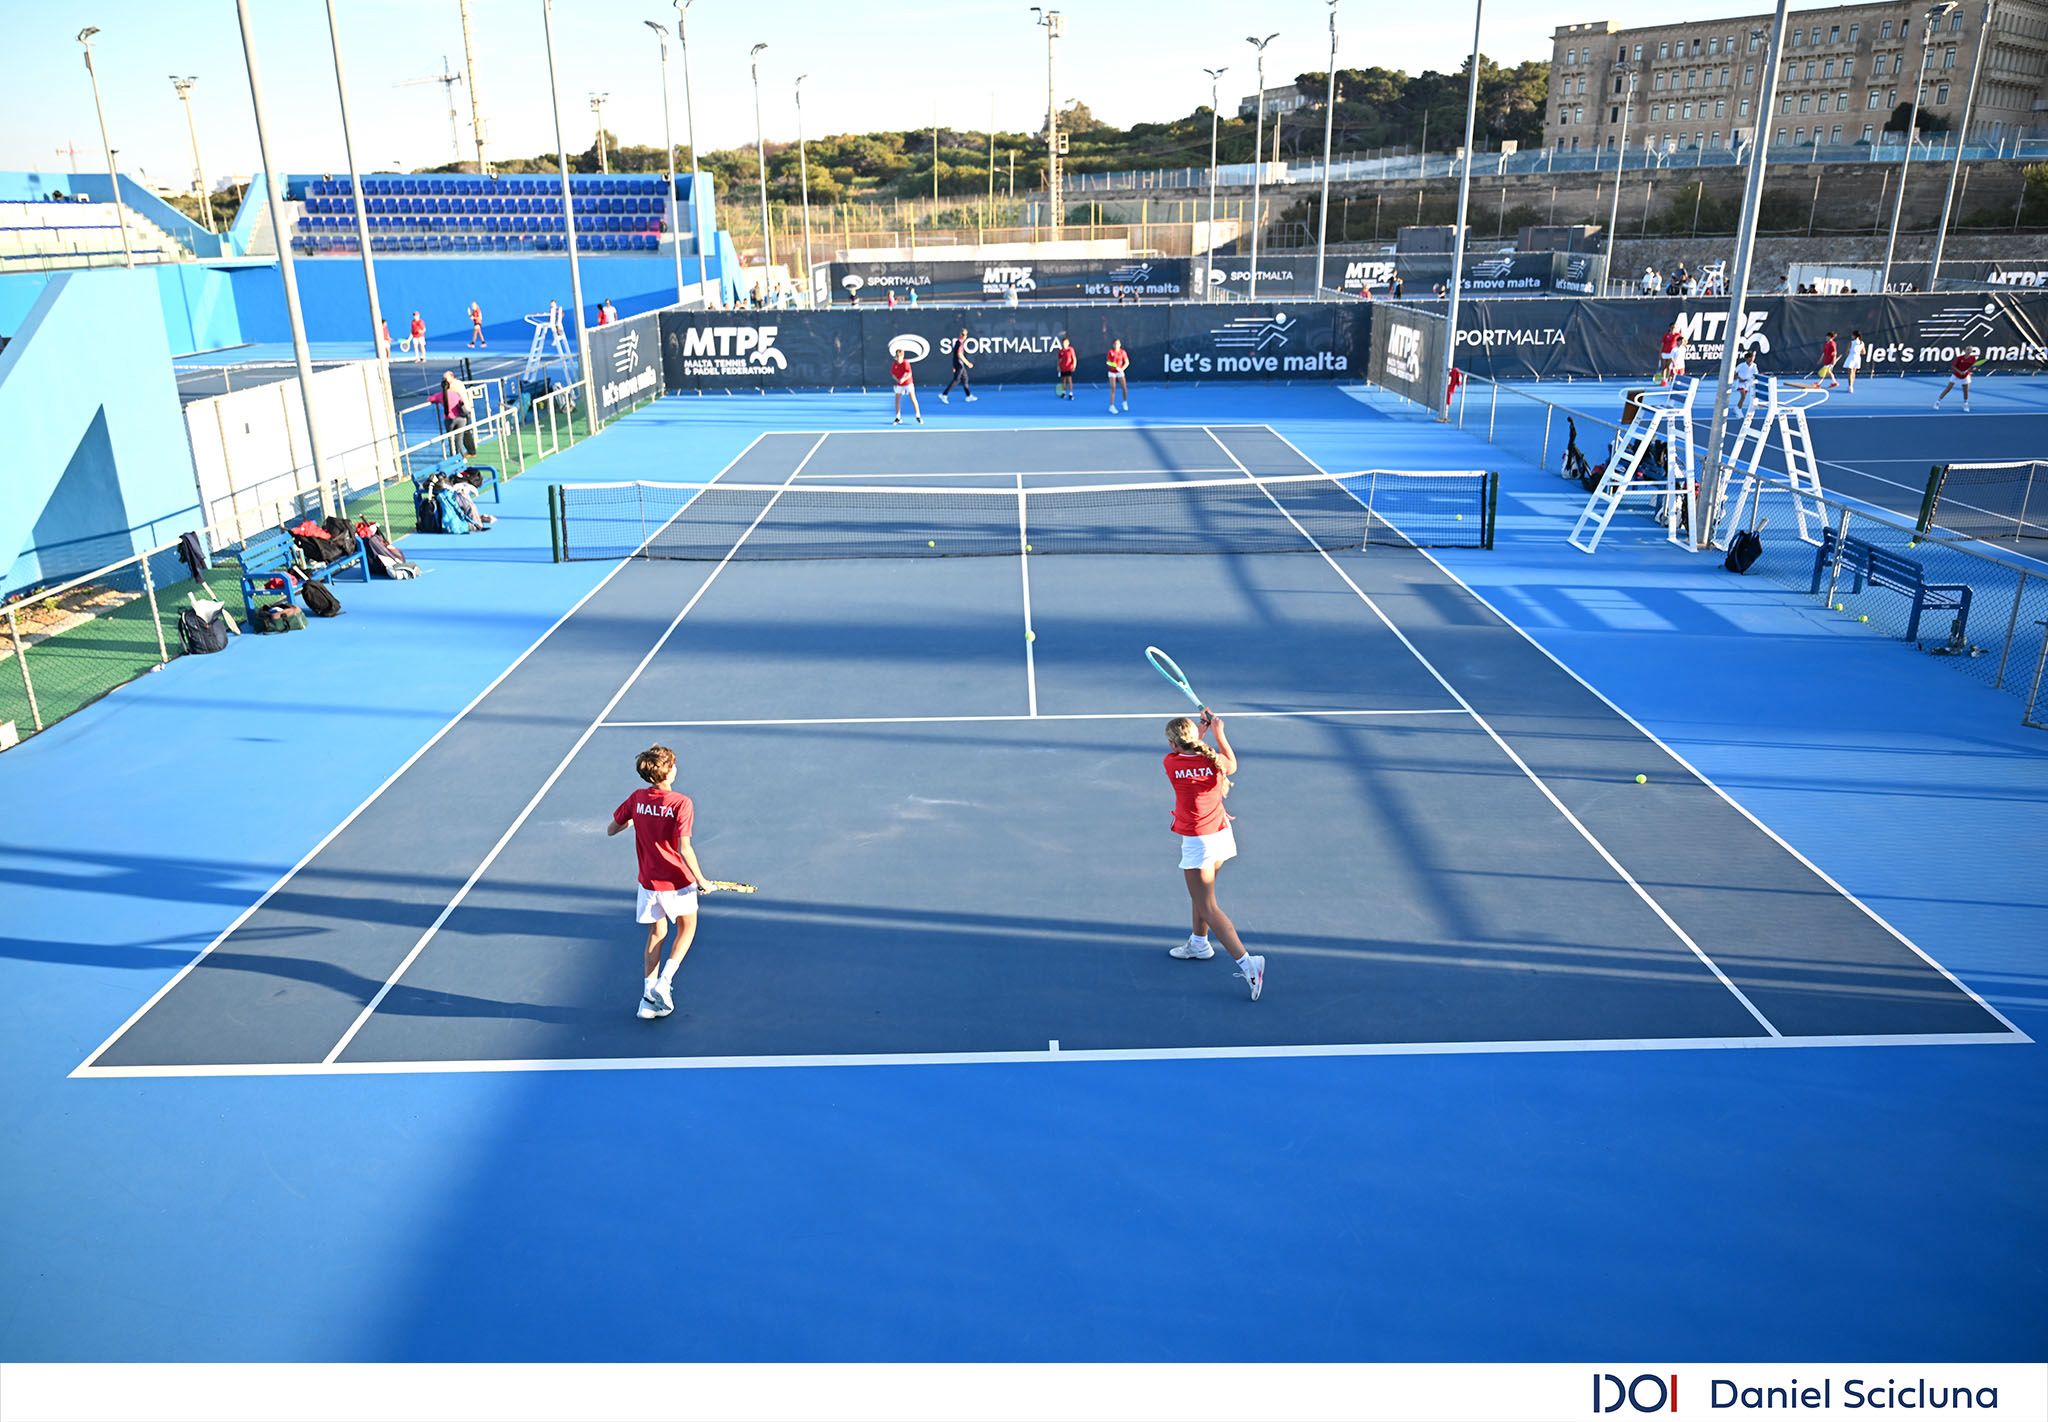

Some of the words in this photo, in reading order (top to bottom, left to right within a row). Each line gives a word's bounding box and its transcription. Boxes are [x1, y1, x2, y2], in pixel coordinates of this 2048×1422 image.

[983, 267, 1033, 284] MTPF
[1345, 262, 1396, 279] MTPF
[867, 276, 931, 287] SPORTMALTA
[1085, 283, 1111, 295] let's
[1113, 285, 1144, 294] ove
[1146, 282, 1180, 294] malta
[1473, 279, 1505, 289] move
[1507, 277, 1541, 288] malta
[683, 326, 778, 357] MTPF
[940, 336, 1063, 354] SORTMALTA
[1388, 323, 1421, 360] MTPF
[1455, 329, 1566, 347] PORTMALTA
[1866, 343, 1915, 363] let's
[684, 359, 713, 368] MALTA
[714, 359, 747, 368] TENNIS
[1164, 353, 1212, 373] let's
[1217, 356, 1278, 372] move
[1283, 351, 1348, 371] malta
[693, 367, 720, 376] PADEL
[721, 366, 775, 375] FEDERATION
[1174, 767, 1214, 779] MALTA
[636, 802, 675, 818] MALTA
